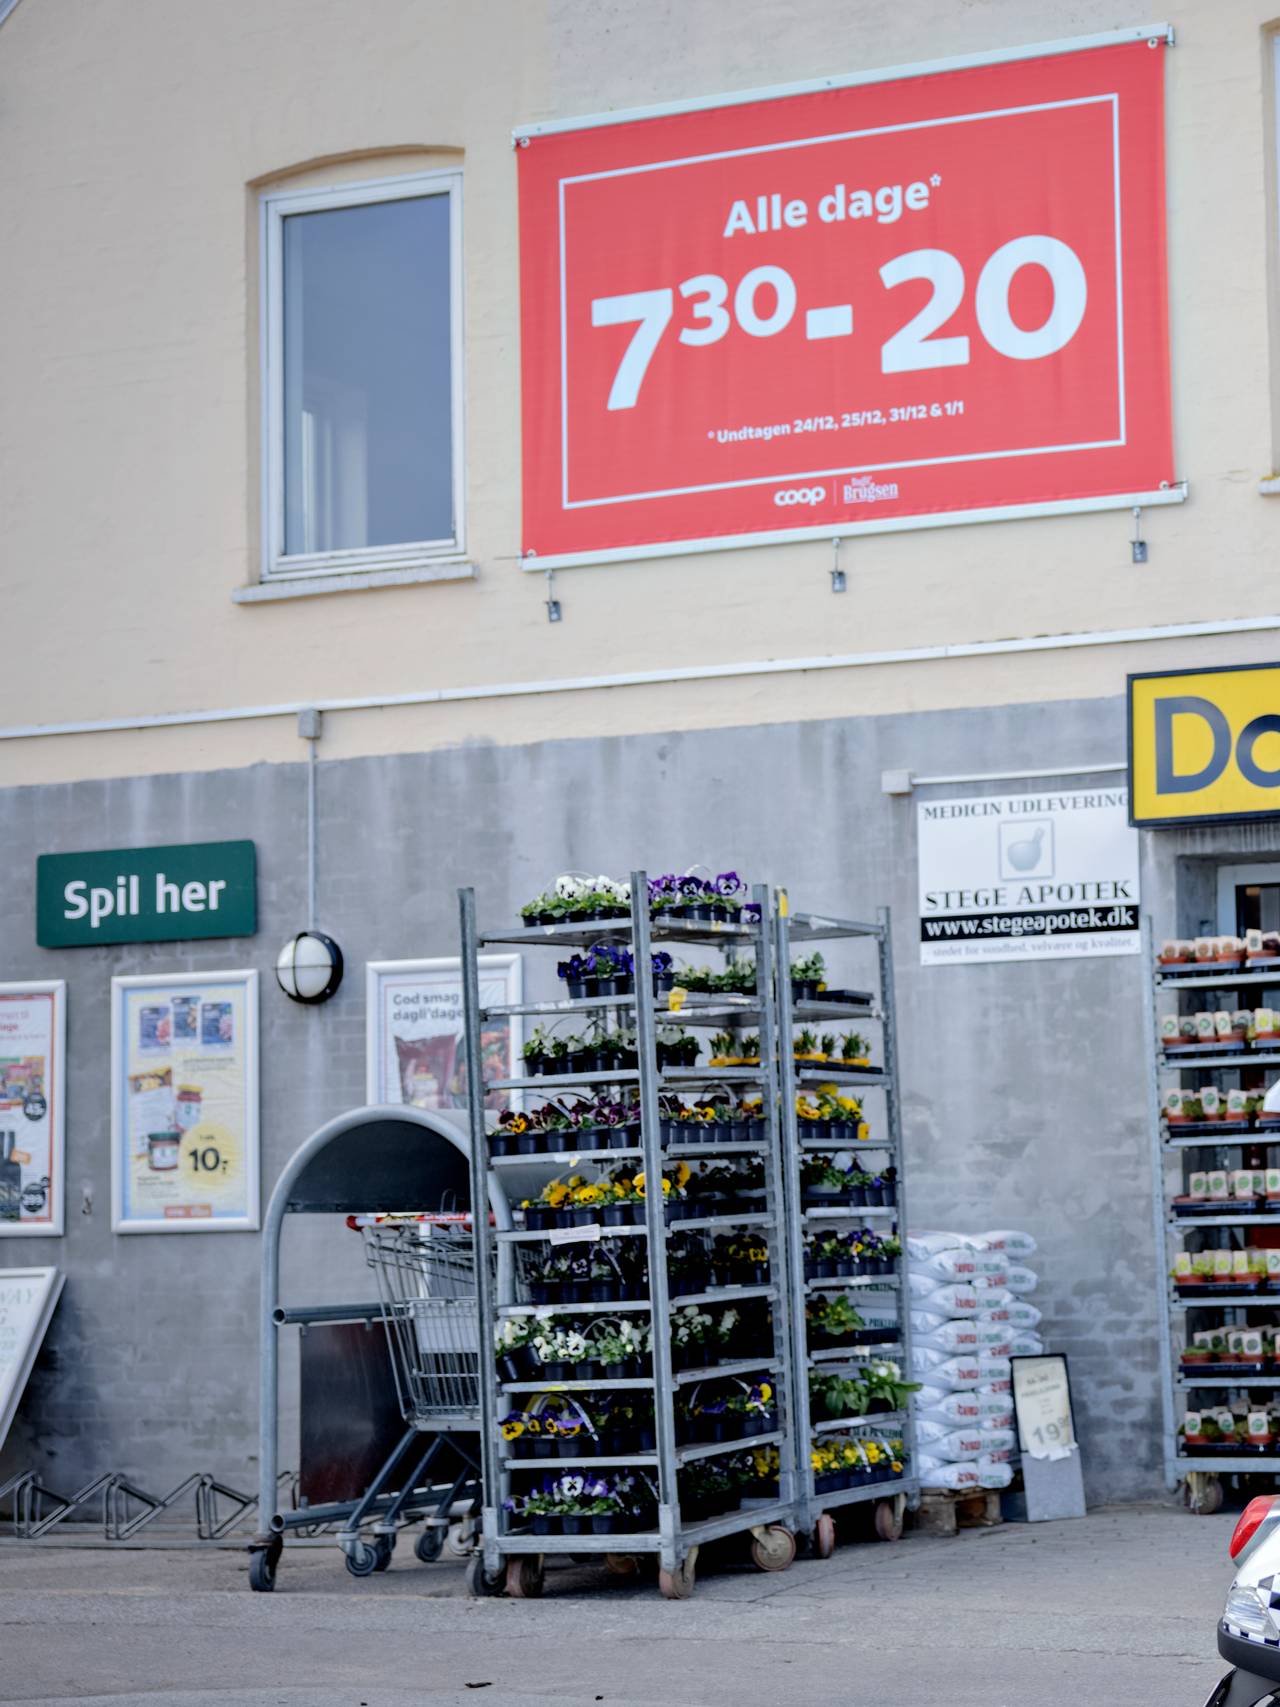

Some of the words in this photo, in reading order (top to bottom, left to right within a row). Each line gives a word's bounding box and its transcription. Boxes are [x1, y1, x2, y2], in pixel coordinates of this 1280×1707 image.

[723, 193, 808, 238] Alle
[879, 234, 1088, 375] 20
[793, 415, 839, 434] 24/12,
[841, 409, 887, 428] 25/12,
[889, 404, 927, 422] 31/12
[930, 403, 943, 418] &
[944, 400, 965, 416] 1/1
[774, 487, 826, 506] coop
[843, 482, 898, 503] Brugsen
[923, 800, 1003, 821] MEDICIN
[63, 876, 140, 929] Spil
[154, 872, 227, 915] her
[925, 887, 1008, 912] STEGE
[1016, 879, 1132, 906] APOTEK
[925, 906, 1135, 937] www.stegeapotek.dk
[393, 993, 420, 1006] God
[423, 992, 460, 1005] smag
